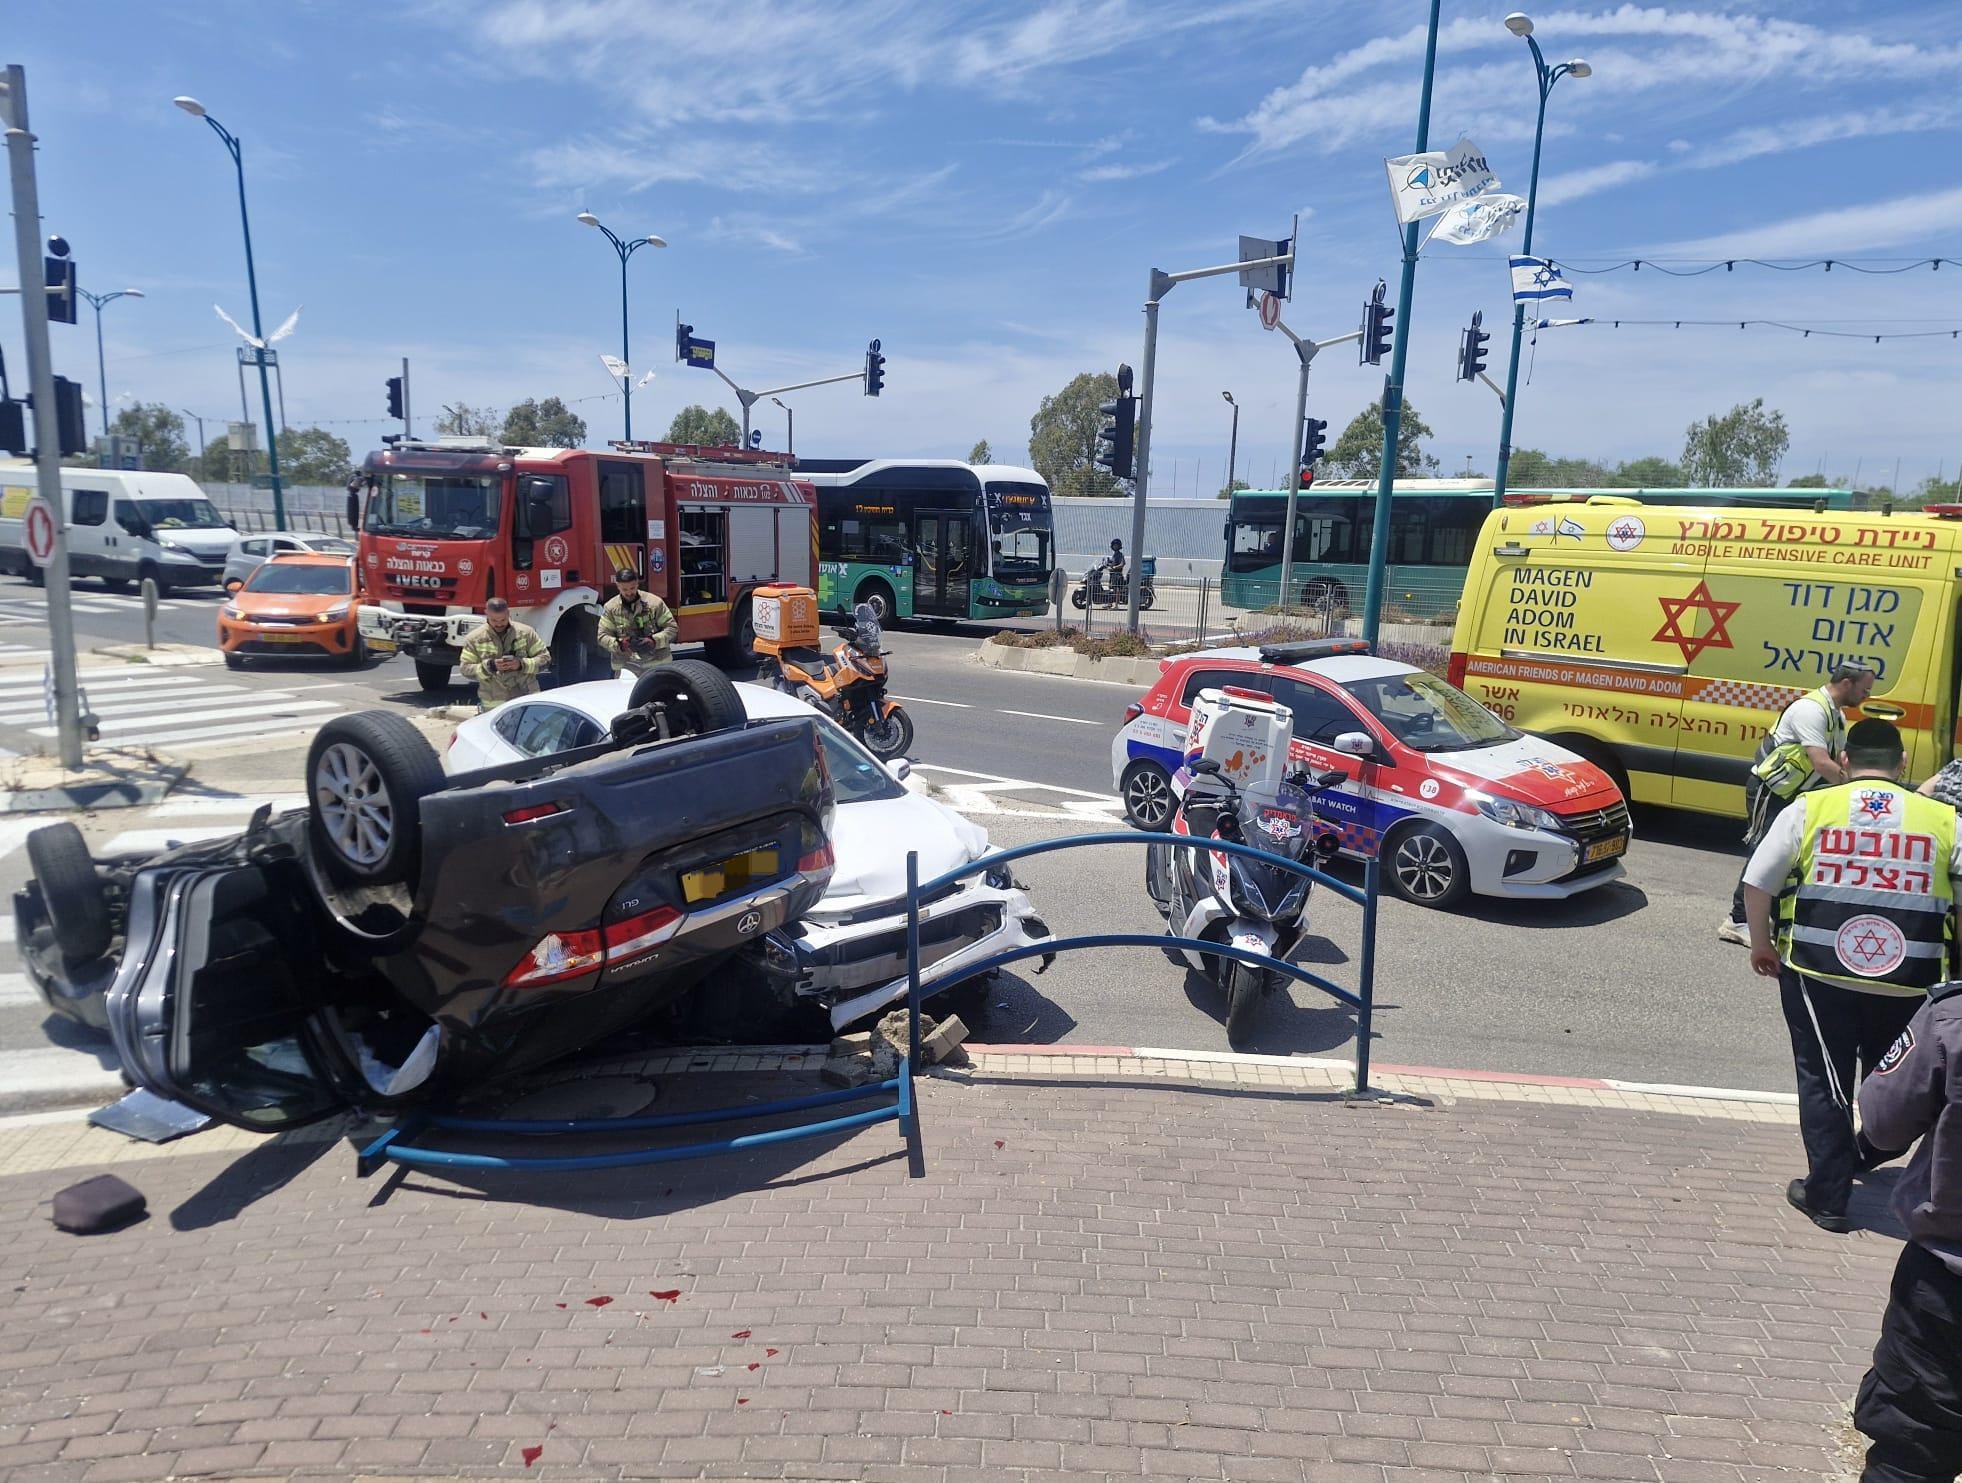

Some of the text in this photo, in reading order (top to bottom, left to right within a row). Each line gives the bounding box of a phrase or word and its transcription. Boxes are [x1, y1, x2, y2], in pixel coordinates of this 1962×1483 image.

[690, 481, 718, 498] והצלה
[733, 486, 758, 499] כבאות
[1678, 519, 1937, 550] ניידת טיפול נמרץ
[386, 556, 446, 573] כבאות והצלה
[1671, 543, 1933, 570] MOBILE INTENSIVE CARE UNIT
[395, 574, 441, 588] IVECO
[1512, 567, 1594, 588] MAGEN
[1510, 587, 1577, 608] DAVID
[1783, 582, 1901, 615] מגן דוד
[1506, 608, 1575, 629] ADOM
[1503, 628, 1606, 653] IN ISRAEL
[1811, 617, 1895, 648] אדום
[1467, 660, 1683, 695] AMERICAN FRIENDS OF MAGEN DAVID ADOM
[1479, 684, 1520, 701] אשר
[1562, 702, 1640, 725] הלאומי
[1650, 711, 1729, 736] ההצלה
[1422, 784, 1437, 794] 138
[1328, 799, 1357, 814] WATCH
[1819, 828, 1932, 863] חובש
[1816, 860, 1930, 894] הצלה
[622, 899, 639, 910] GLI
